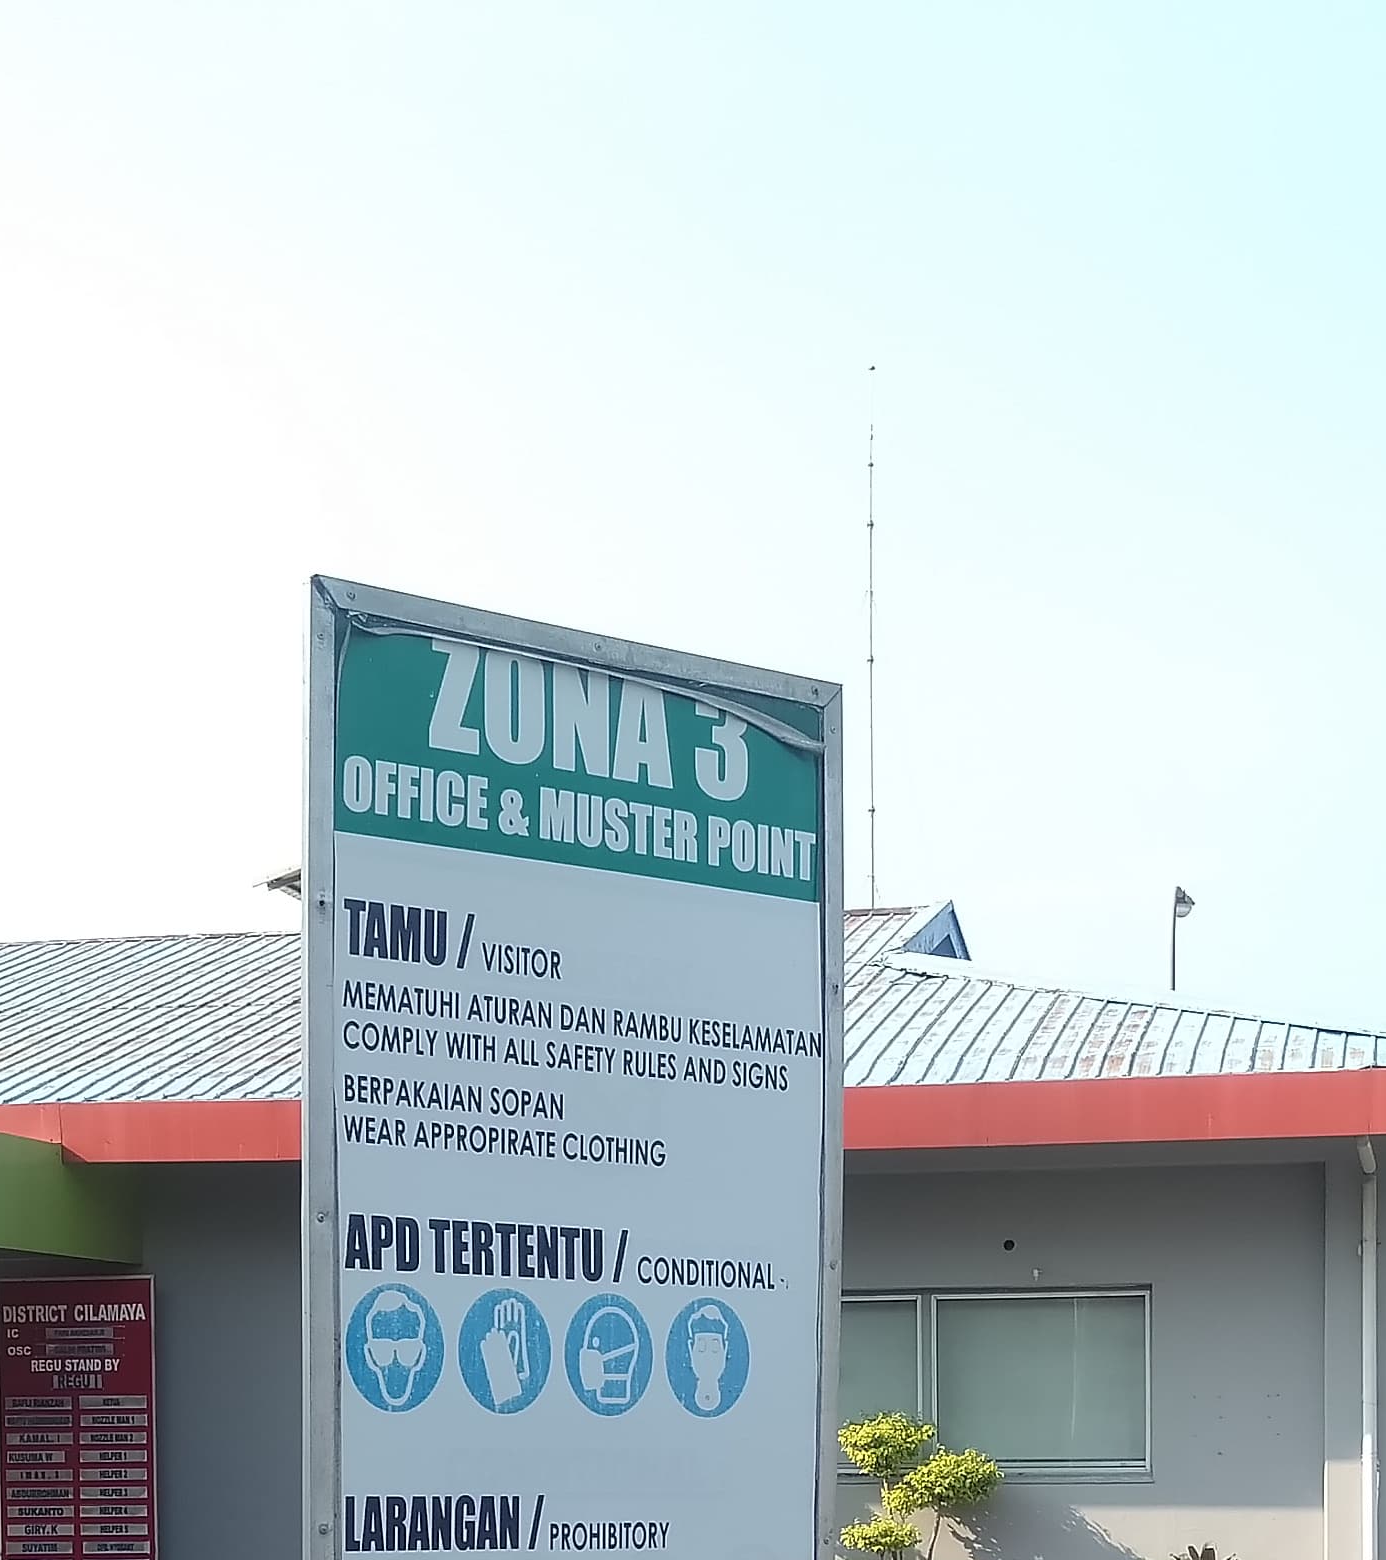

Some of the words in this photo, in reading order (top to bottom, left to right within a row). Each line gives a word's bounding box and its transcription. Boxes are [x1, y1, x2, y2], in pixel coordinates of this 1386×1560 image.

[428, 638, 674, 790] ZONA
[694, 700, 751, 802] 3
[342, 755, 490, 831] OFFICE
[498, 788, 530, 837] &
[539, 786, 698, 865] MUSTER
[708, 814, 817, 883] POINT
[343, 897, 448, 966] TAMU
[481, 941, 562, 980] VISITOR
[342, 979, 461, 1021] MEMATUHI
[466, 987, 553, 1030] ATURAN
[560, 1003, 607, 1035] DAN
[613, 1008, 683, 1045] RAMBU
[688, 1016, 823, 1059] KESELAMATAN
[342, 1019, 438, 1061] COMPLY
[445, 1031, 497, 1066] WITH
[503, 1037, 540, 1068] ALL
[545, 1040, 616, 1076] SAFETY
[623, 1048, 677, 1081] RULES
[683, 1053, 726, 1086] AND
[731, 1058, 790, 1093] SIGNS
[342, 1073, 483, 1117] BERPAKAIAN
[489, 1086, 565, 1121] SOPAN
[342, 1114, 408, 1150] WEAR
[413, 1120, 557, 1162] APPROPIRATE
[562, 1131, 667, 1169] CLOTHING
[344, 1213, 421, 1274] APD
[429, 1217, 605, 1283] TERTENTU
[637, 1255, 776, 1291] CONDITIONAL
[3, 1304, 67, 1324] DISTRICT
[74, 1303, 146, 1322] CILAMAYA
[7, 1329, 19, 1339] IC
[7, 1346, 32, 1356] OSC
[31, 1359, 62, 1372] REGU
[65, 1359, 102, 1372] STAND
[104, 1358, 120, 1371] BY
[58, 1374, 90, 1389] REGU
[344, 1494, 521, 1553] LARANGAN
[549, 1521, 670, 1552] PROHIBITORY
